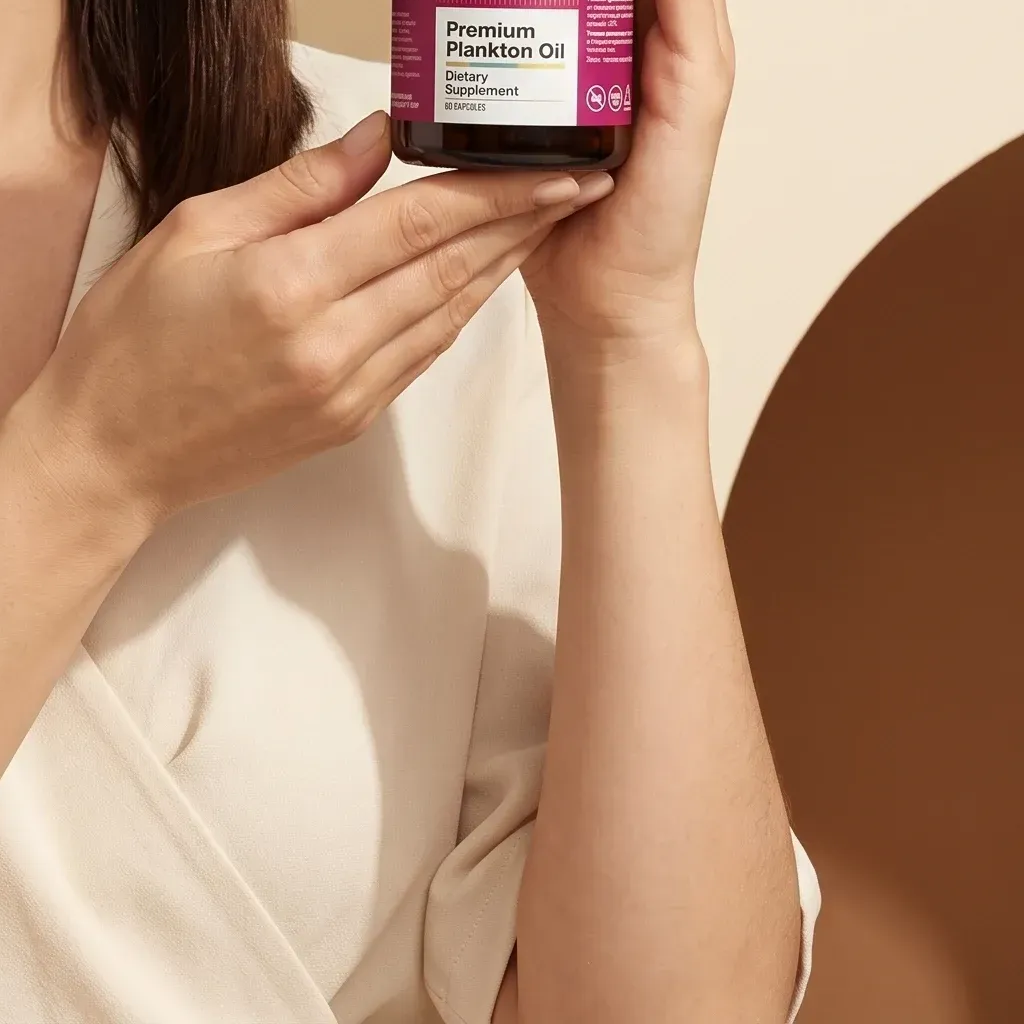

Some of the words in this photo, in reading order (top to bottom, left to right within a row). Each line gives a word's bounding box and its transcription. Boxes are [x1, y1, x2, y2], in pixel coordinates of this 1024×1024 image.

[446, 21, 535, 38] Premium
[446, 41, 533, 58] Plankton
[539, 43, 565, 59] Oil
[445, 70, 488, 84] Dietary
[445, 84, 519, 97] Supplement
